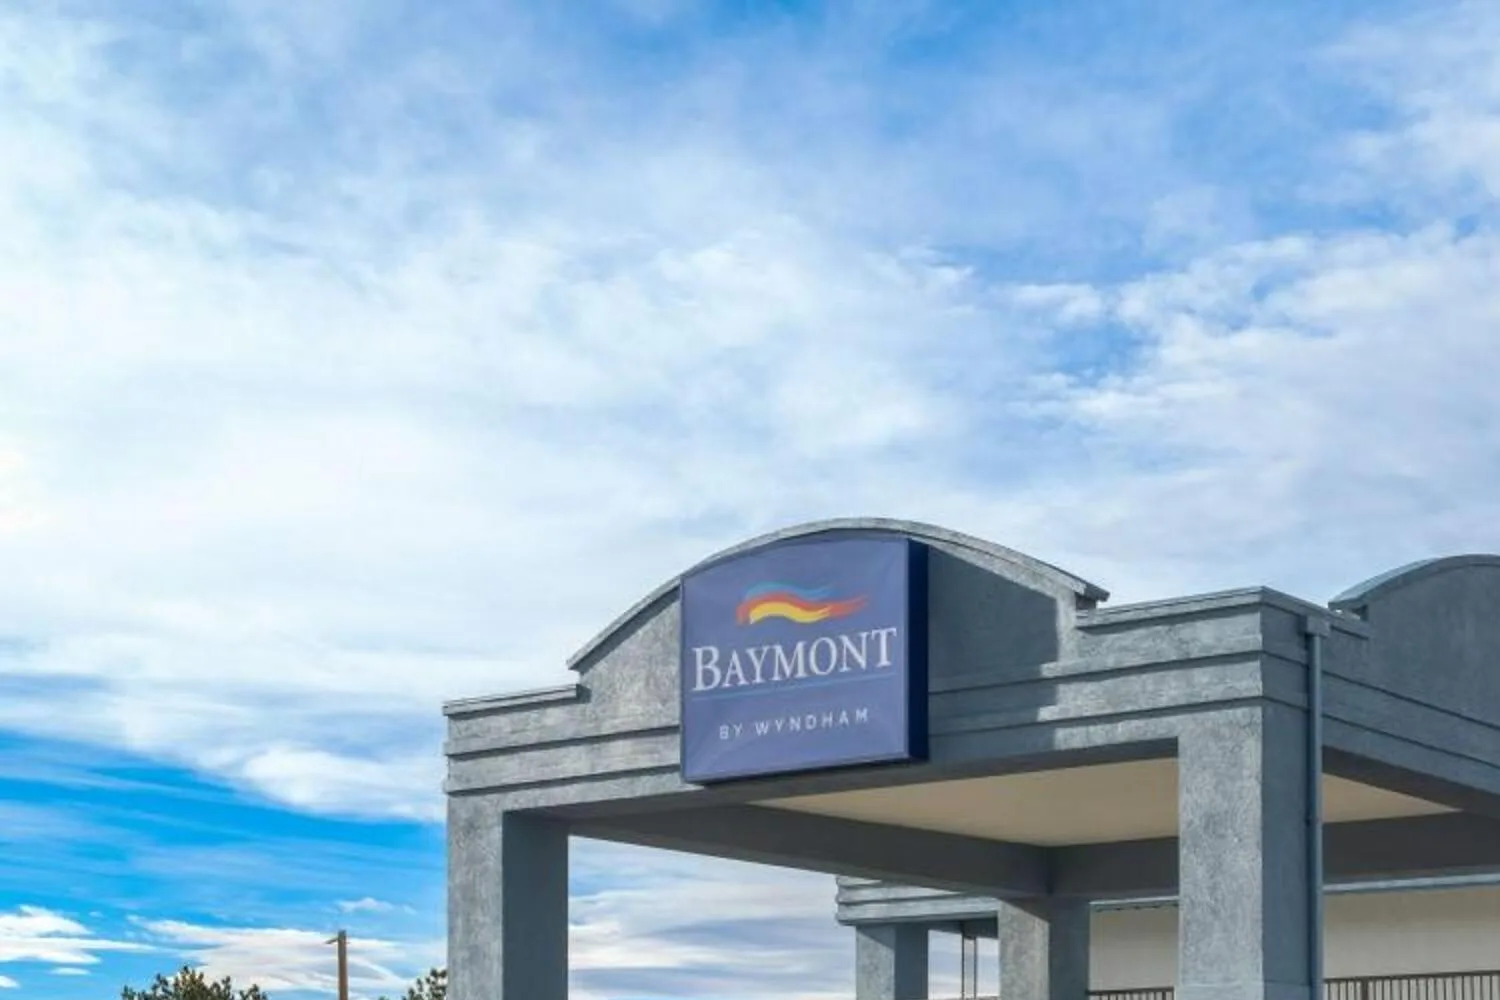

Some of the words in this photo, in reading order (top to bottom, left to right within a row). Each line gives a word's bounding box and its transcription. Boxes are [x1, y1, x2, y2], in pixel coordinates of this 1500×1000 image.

[692, 627, 897, 692] BAYMONT
[719, 723, 743, 740] BY
[755, 708, 869, 736] WYNDHAM
